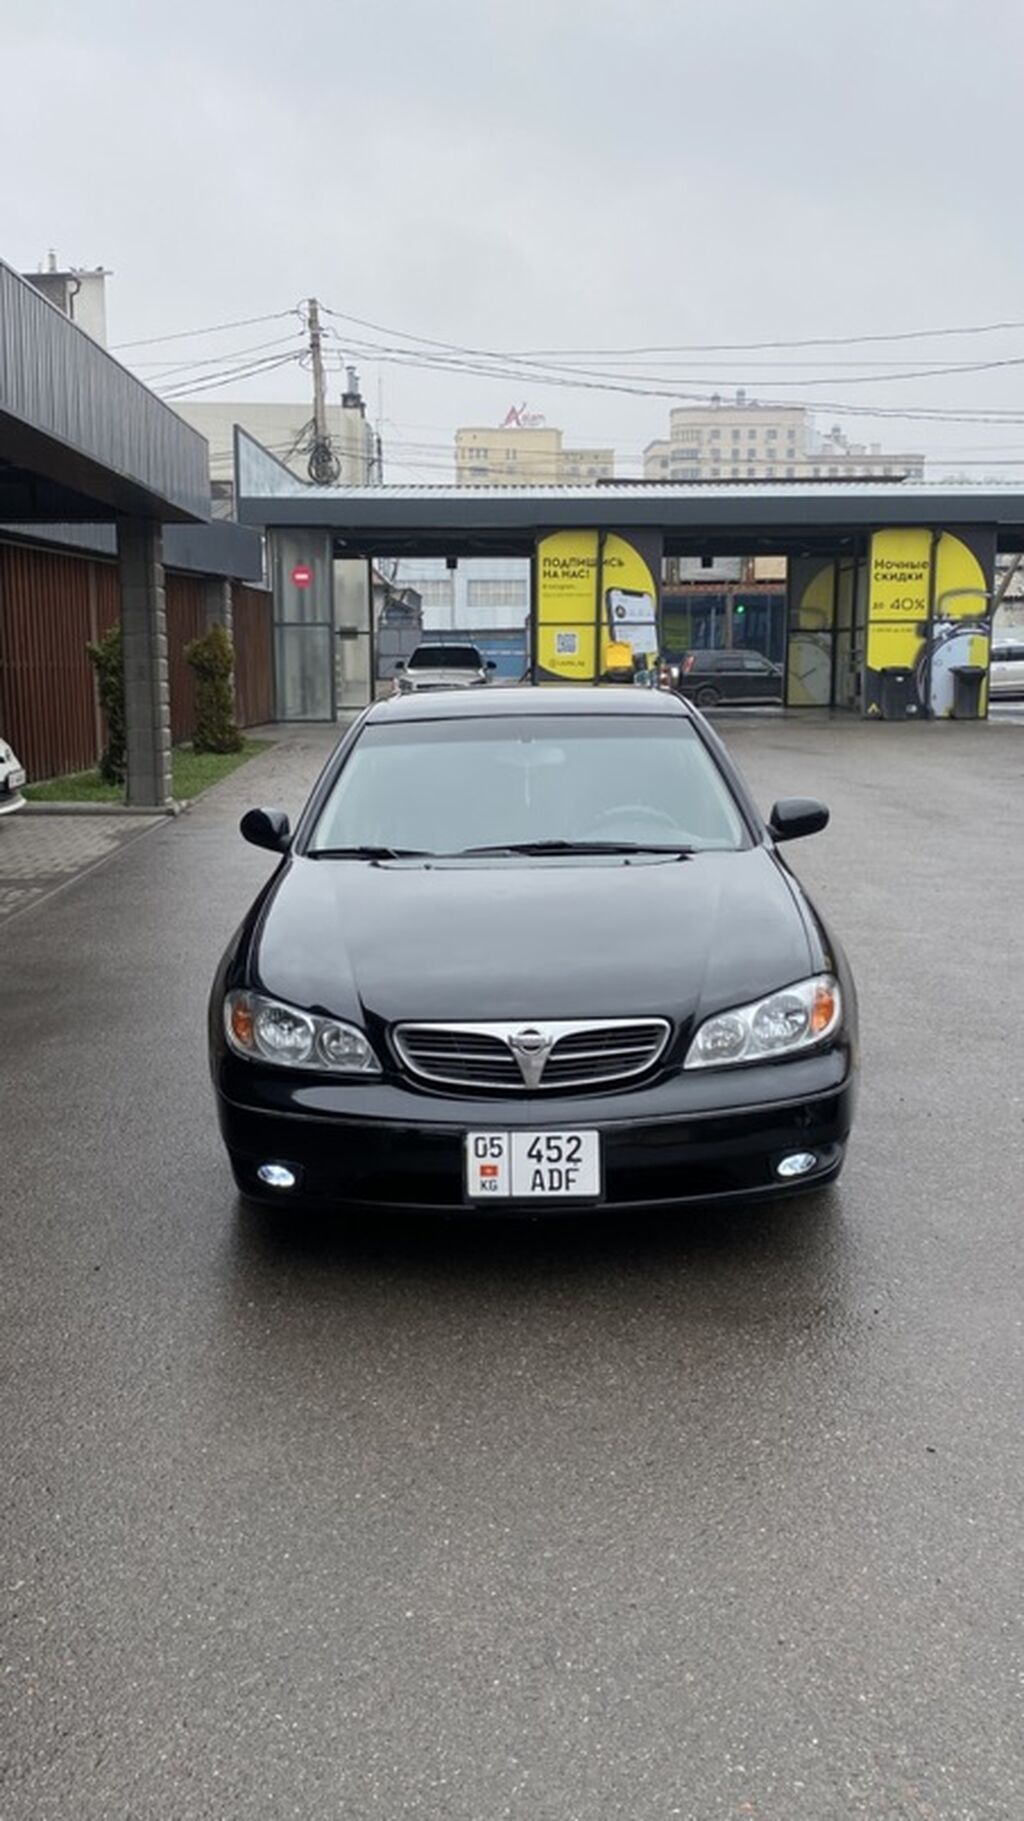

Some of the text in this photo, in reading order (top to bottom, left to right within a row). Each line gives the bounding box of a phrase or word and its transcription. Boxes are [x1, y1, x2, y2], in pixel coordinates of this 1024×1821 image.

[874, 559, 929, 569] Ночные
[543, 569, 590, 579] НА НАС!
[890, 598, 925, 611] 40%
[474, 1136, 503, 1158] 05
[527, 1135, 583, 1163] 452
[480, 1180, 498, 1191] KG
[531, 1168, 579, 1191] ADF
